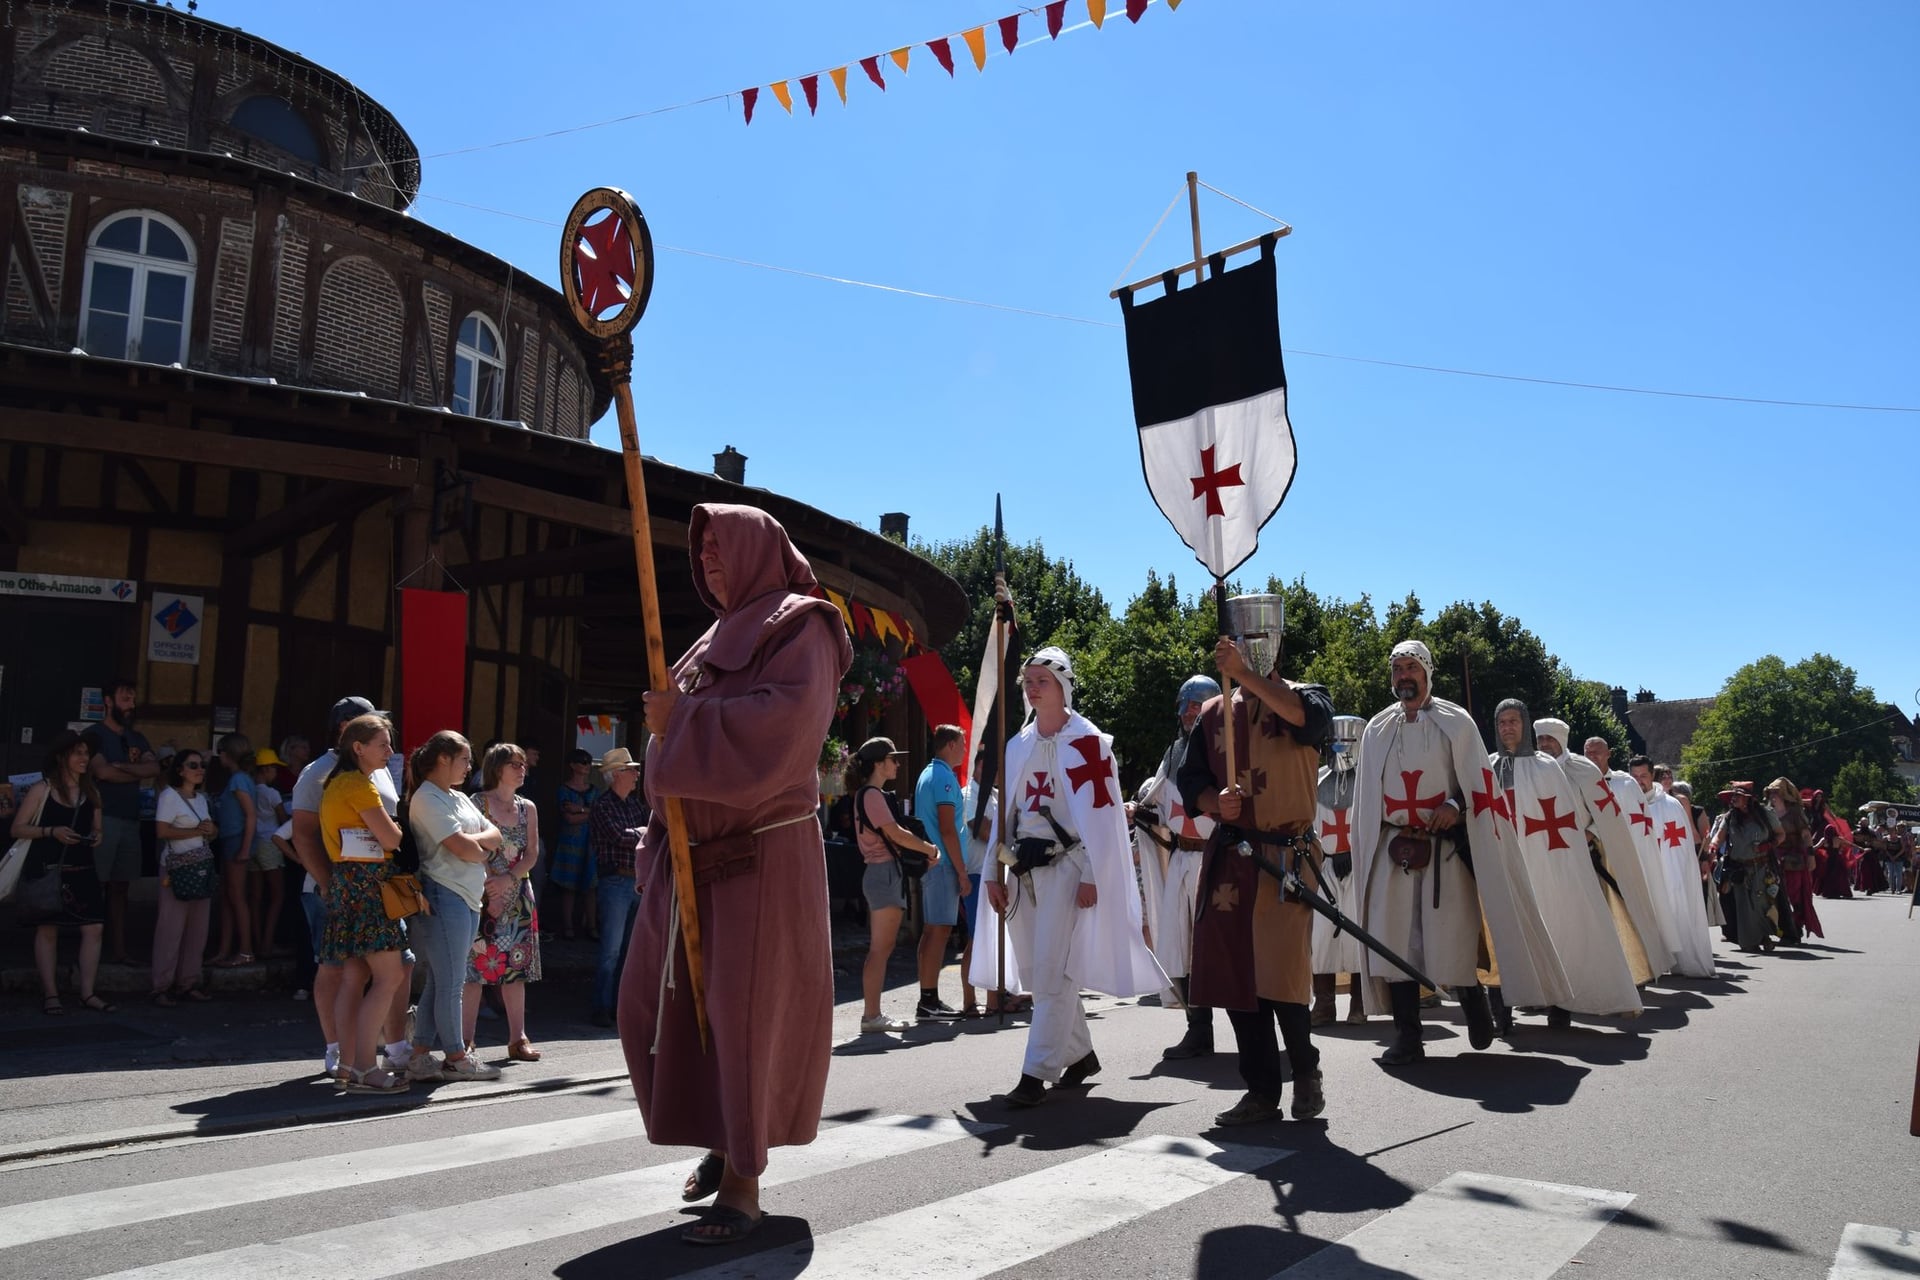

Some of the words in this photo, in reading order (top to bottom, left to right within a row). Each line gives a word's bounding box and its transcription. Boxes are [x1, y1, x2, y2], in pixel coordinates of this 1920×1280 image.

[18, 578, 102, 595] Othe-Armance
[153, 641, 182, 651] OFFICE
[184, 644, 195, 652] DE
[153, 649, 194, 659] TOURISME
